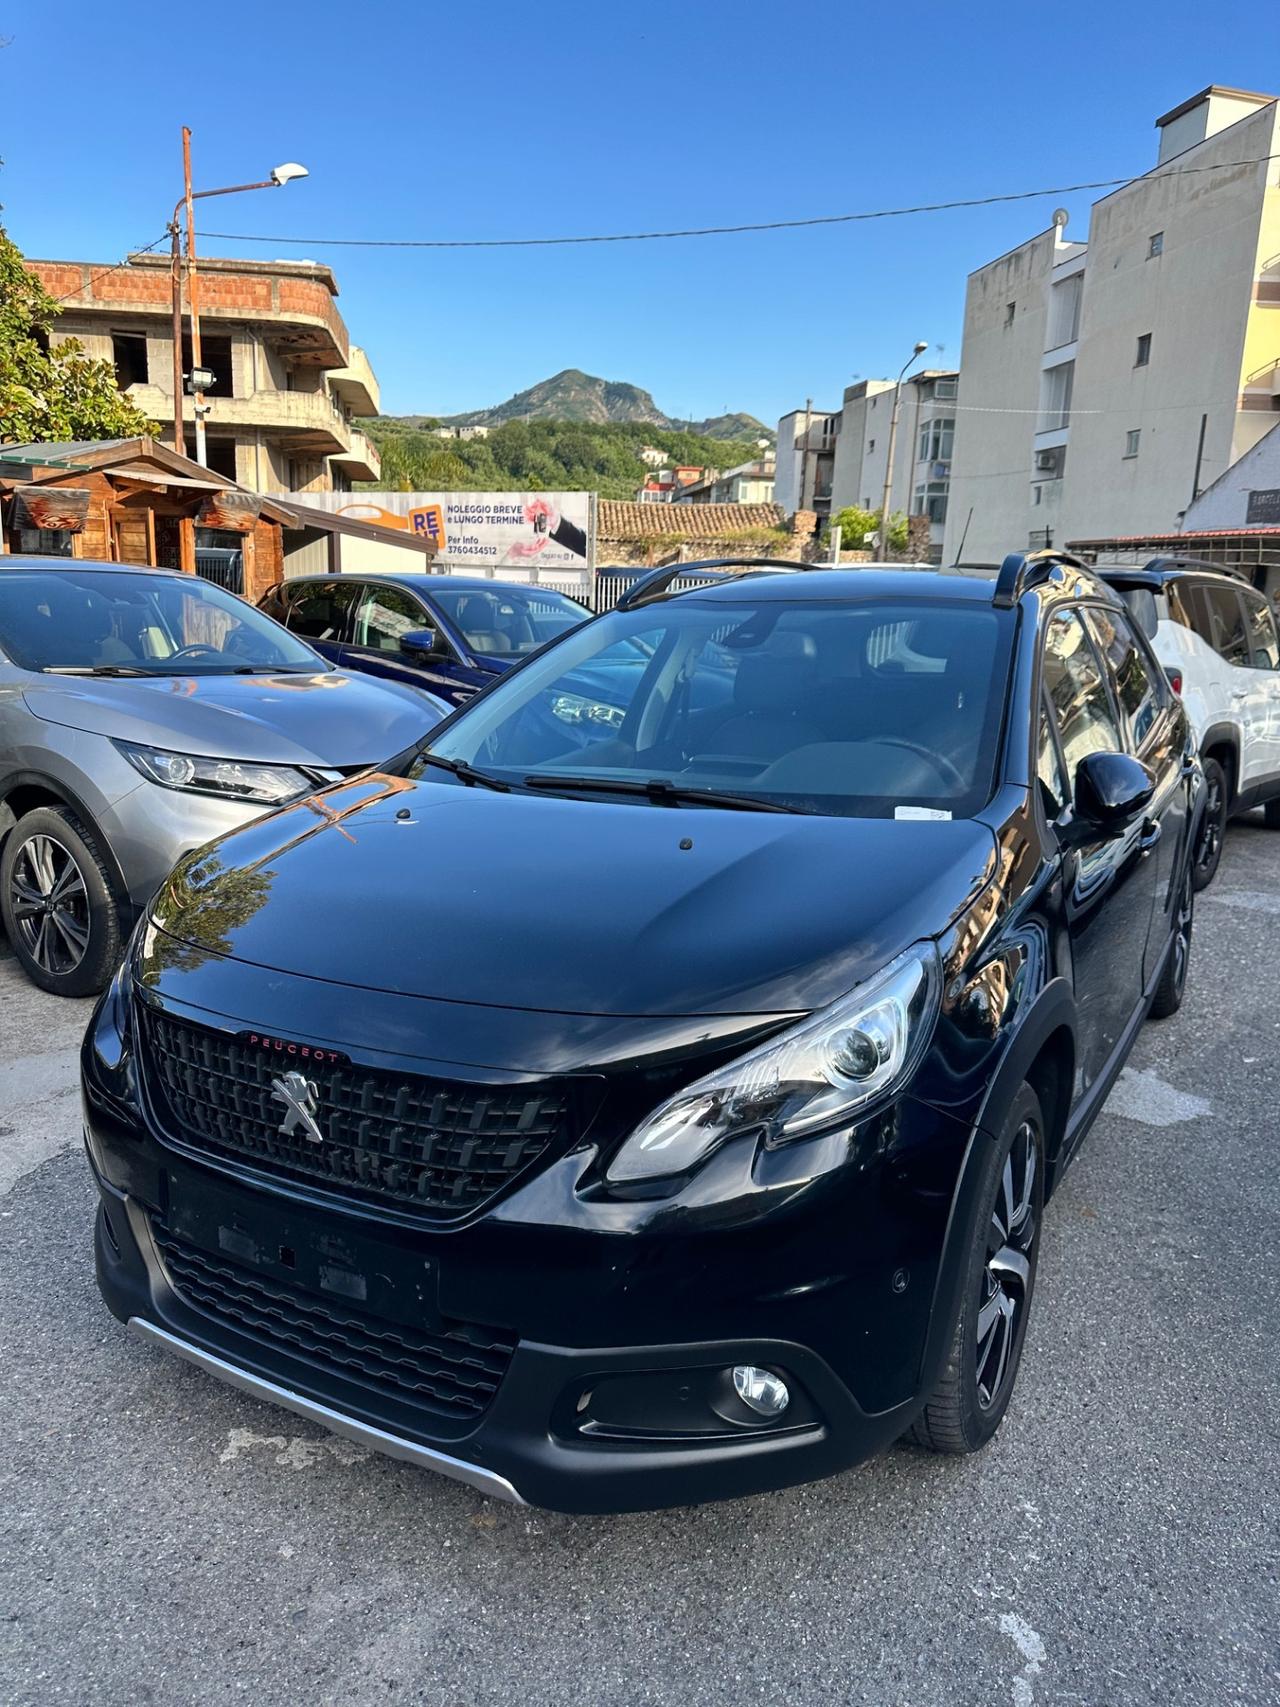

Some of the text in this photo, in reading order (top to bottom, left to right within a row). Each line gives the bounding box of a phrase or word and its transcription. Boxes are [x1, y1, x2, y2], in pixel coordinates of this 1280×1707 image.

[447, 505, 523, 514] NOLEGGIO BREVE
[413, 511, 438, 531] RE
[454, 516, 484, 524] LUNGO
[485, 516, 525, 525] TERMINE
[447, 535, 479, 544] Per Info
[447, 546, 497, 555] 3760434512
[250, 1035, 338, 1063] PEUGEOT
